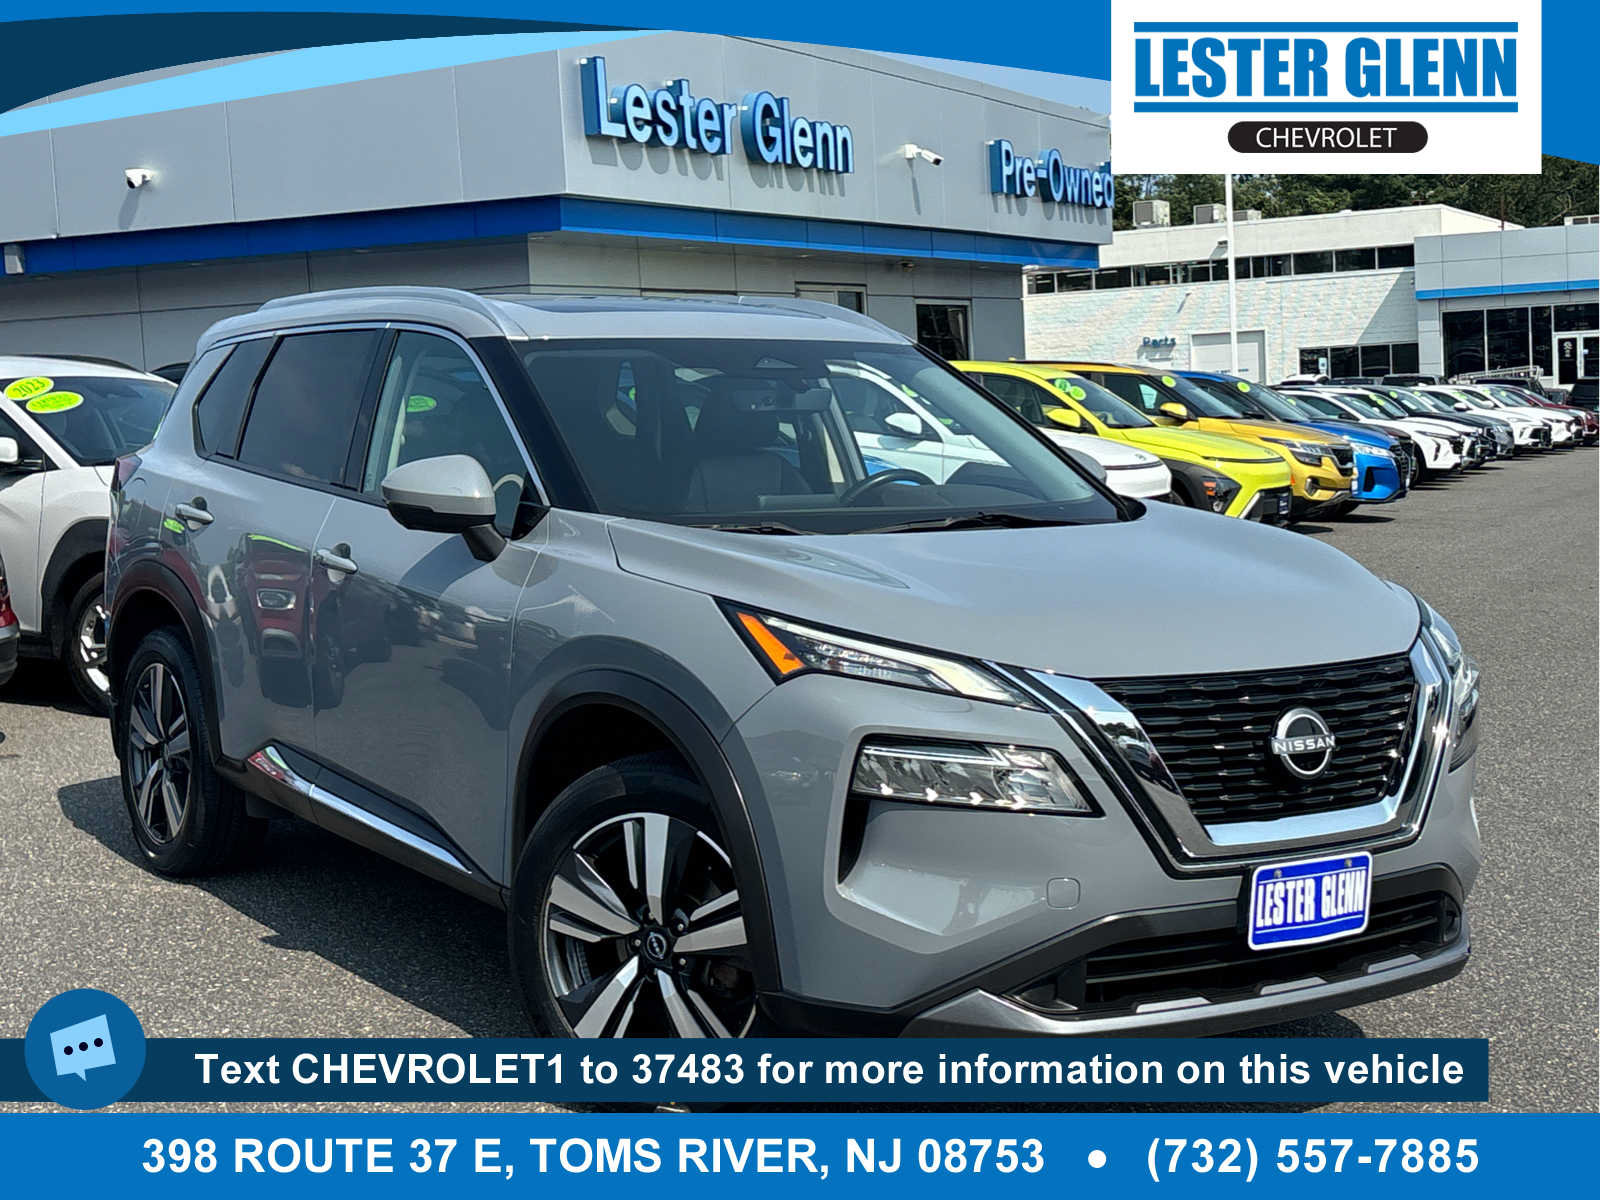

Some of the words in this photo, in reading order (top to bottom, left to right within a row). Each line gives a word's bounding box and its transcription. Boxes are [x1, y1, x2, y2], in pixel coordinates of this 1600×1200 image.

[581, 56, 737, 155] Lester
[742, 90, 854, 174] Glenn
[991, 138, 1115, 208] Pre-Owned
[1142, 336, 1176, 347] Parts
[1273, 736, 1336, 754] NISSAN
[1255, 877, 1316, 928] LESTER
[1320, 869, 1368, 919] GLENN
